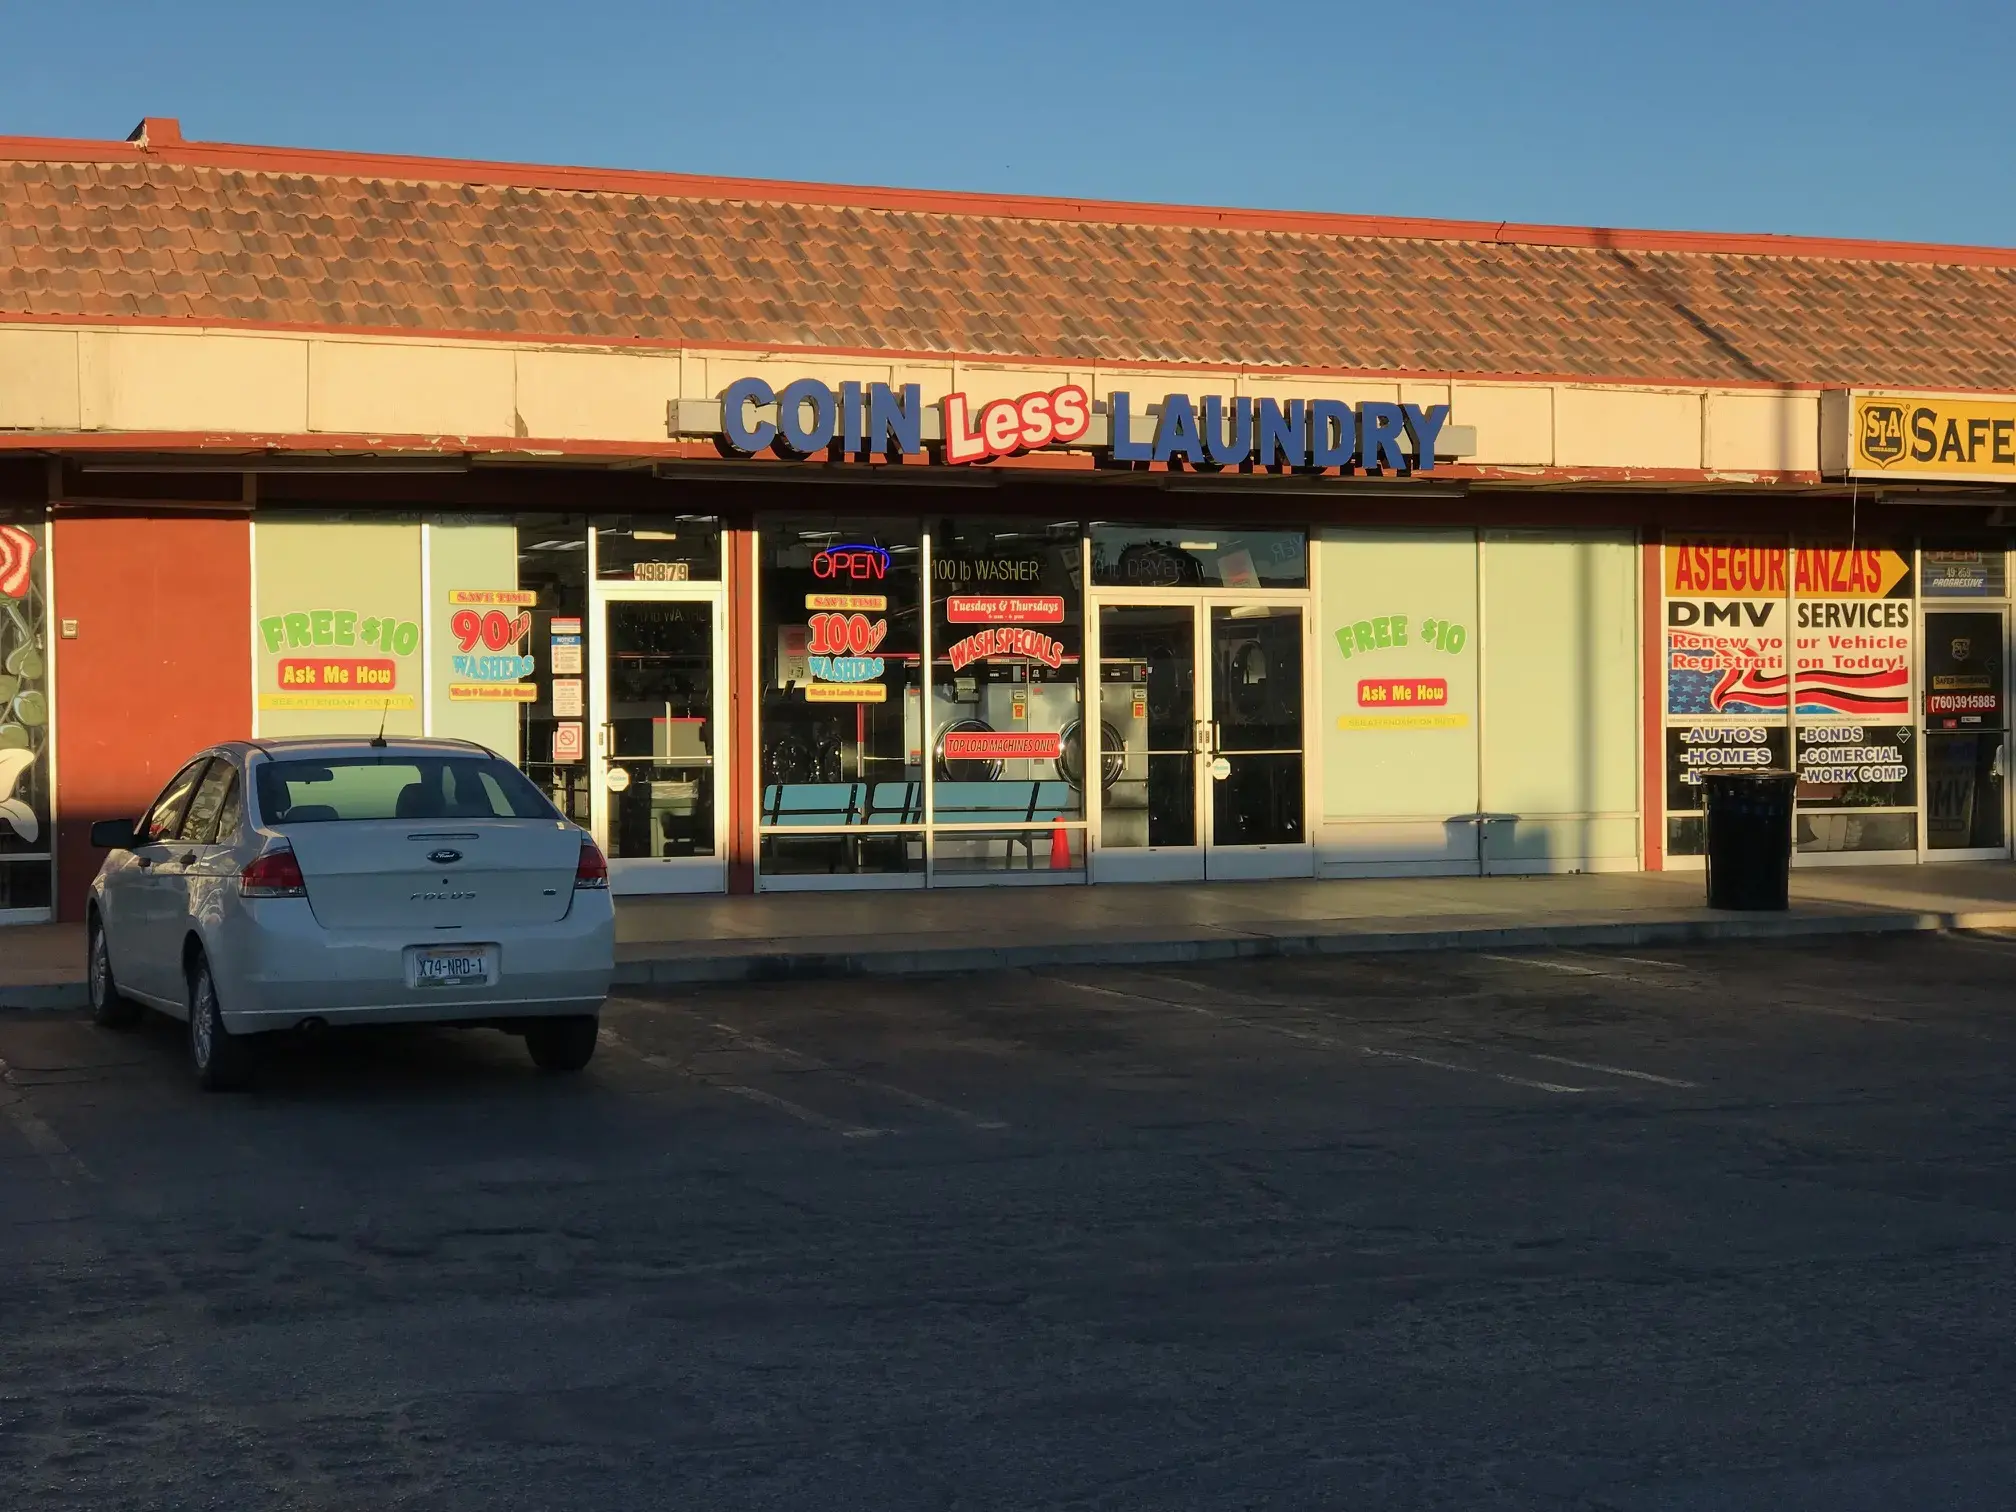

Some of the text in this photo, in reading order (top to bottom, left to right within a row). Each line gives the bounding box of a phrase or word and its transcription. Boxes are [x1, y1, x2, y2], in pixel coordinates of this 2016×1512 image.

[721, 377, 1450, 470] COIN Less LAUNDRY
[634, 563, 688, 581] 49879
[813, 552, 886, 579] OPEN
[932, 560, 1040, 581] 100 lb WASHER
[1932, 578, 1984, 588] PROGRESSIVE
[456, 592, 531, 603] SAVE TIME
[813, 597, 882, 608] SAVE TIME
[953, 600, 1059, 614] Tuesdays & Thursdays
[1668, 601, 1909, 628] DMV SERVICES
[259, 609, 419, 656] FREE $10
[1334, 614, 1467, 660] FREE $10
[1672, 634, 1750, 649] Renew
[1828, 634, 1909, 649] Vehicle
[949, 628, 1064, 672] WASH SPECIALS
[452, 655, 535, 680] WASHERS
[808, 657, 885, 683] WASHERS
[1832, 654, 1905, 673] Today!
[283, 665, 391, 684] Ask Me How
[1362, 684, 1444, 700] Ask Me How
[948, 739, 1056, 752] TOP LOAD MACHINES ONLY
[1859, 765, 1908, 783] COMP
[410, 891, 477, 901] FOCUS
